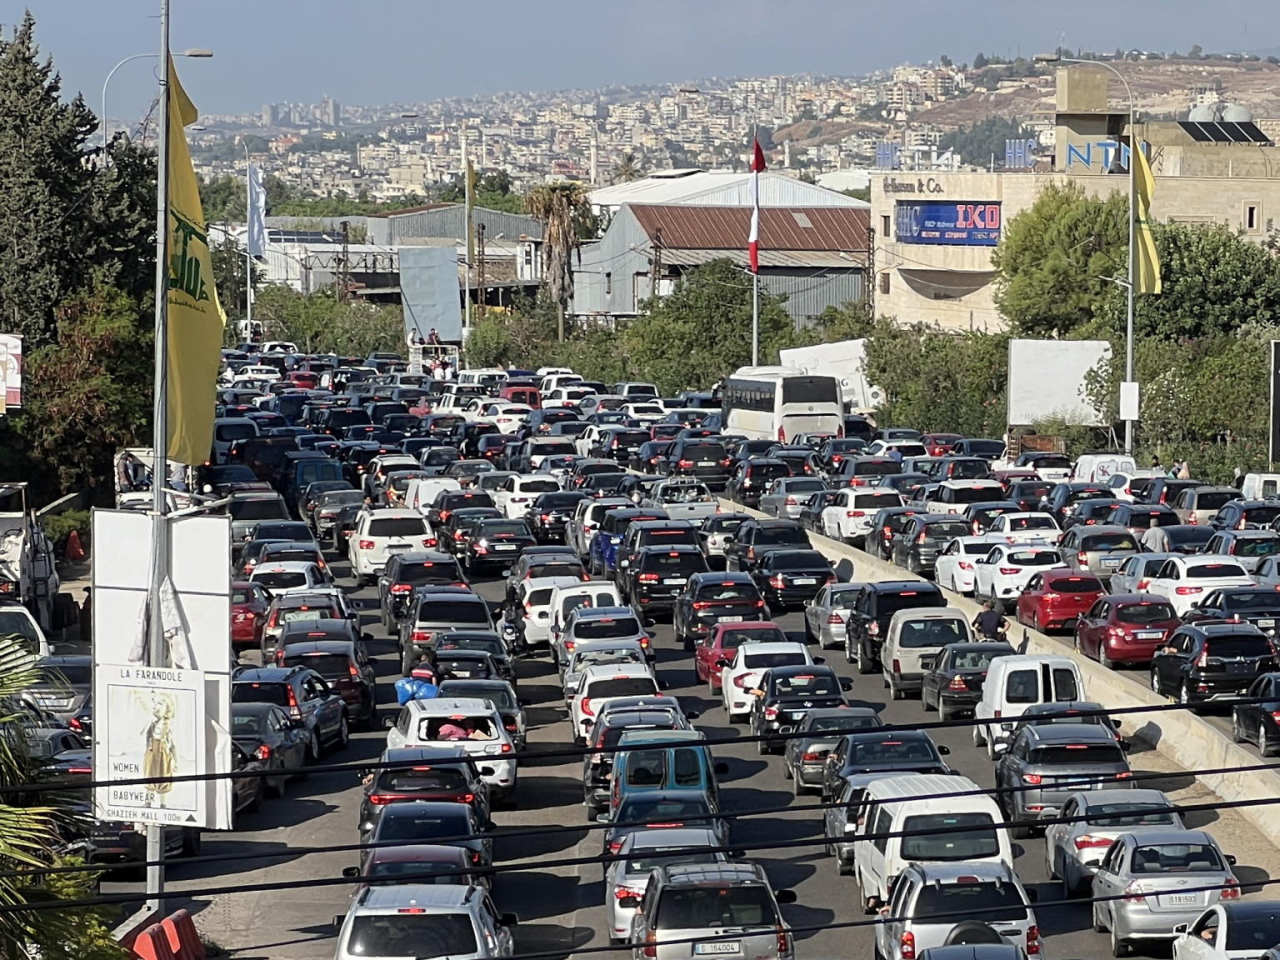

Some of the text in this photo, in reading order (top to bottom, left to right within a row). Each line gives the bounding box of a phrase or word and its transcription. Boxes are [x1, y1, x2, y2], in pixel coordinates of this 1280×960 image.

[1006, 139, 1036, 168] HHC
[956, 204, 999, 229] IKO
[121, 669, 182, 681] LA FARANDOLE
[113, 763, 140, 773] WOMEN
[113, 791, 155, 802] BABYWEAR
[141, 812, 158, 820] MALL
